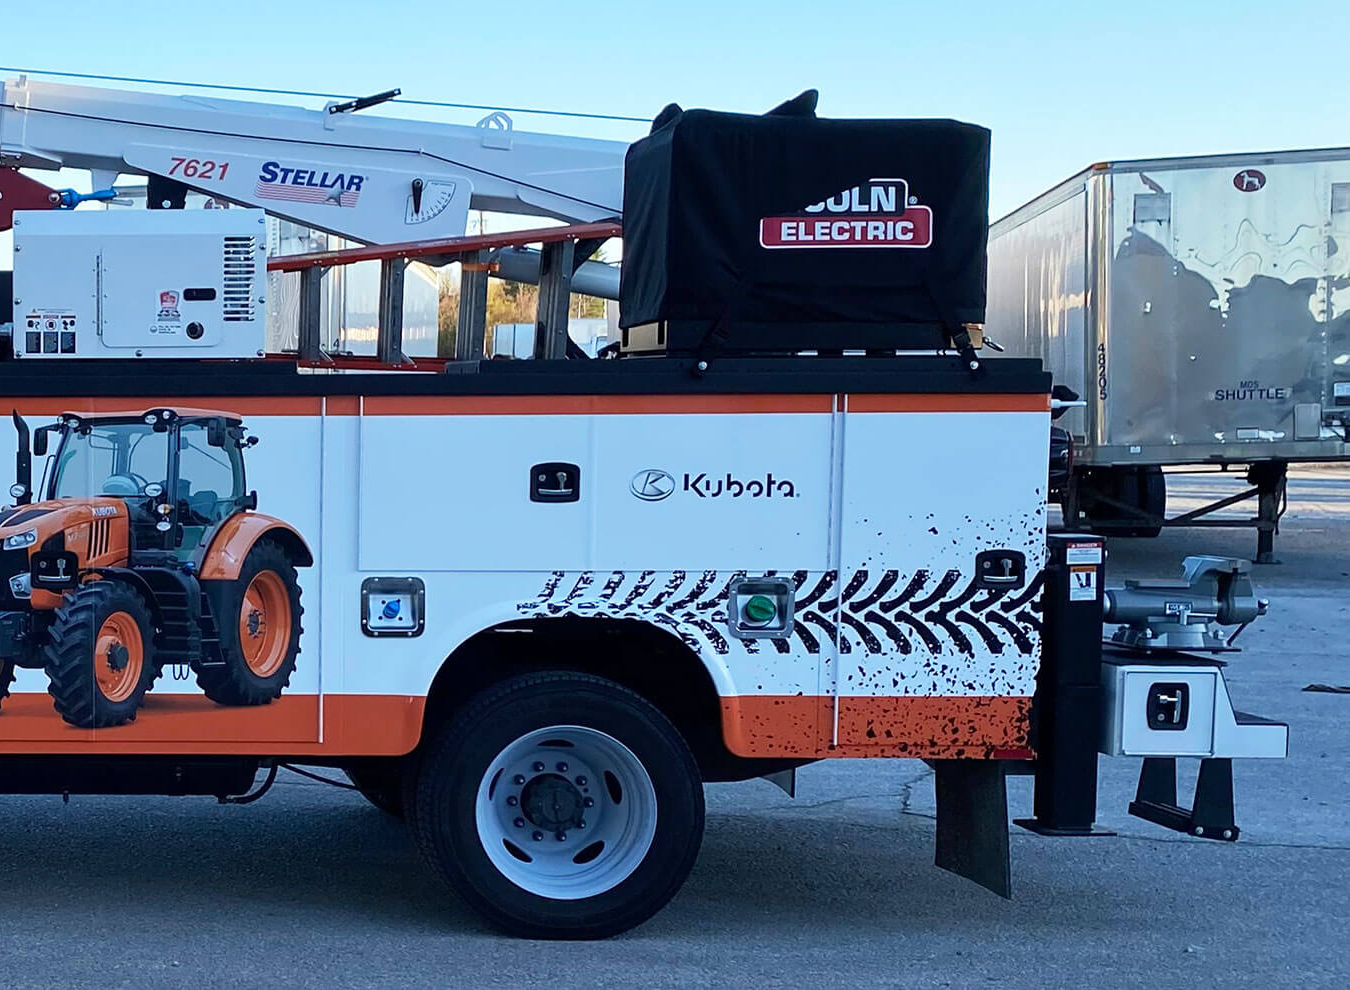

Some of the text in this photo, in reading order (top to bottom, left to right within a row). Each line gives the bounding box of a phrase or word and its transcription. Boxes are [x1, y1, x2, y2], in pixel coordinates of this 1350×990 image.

[168, 157, 230, 181] 7621
[259, 161, 365, 192] STELLAR
[781, 221, 914, 241] ELECTRIC
[1097, 343, 1107, 400] 48205
[1215, 388, 1284, 401] SHUTTLE
[683, 473, 795, 498] Kubota
